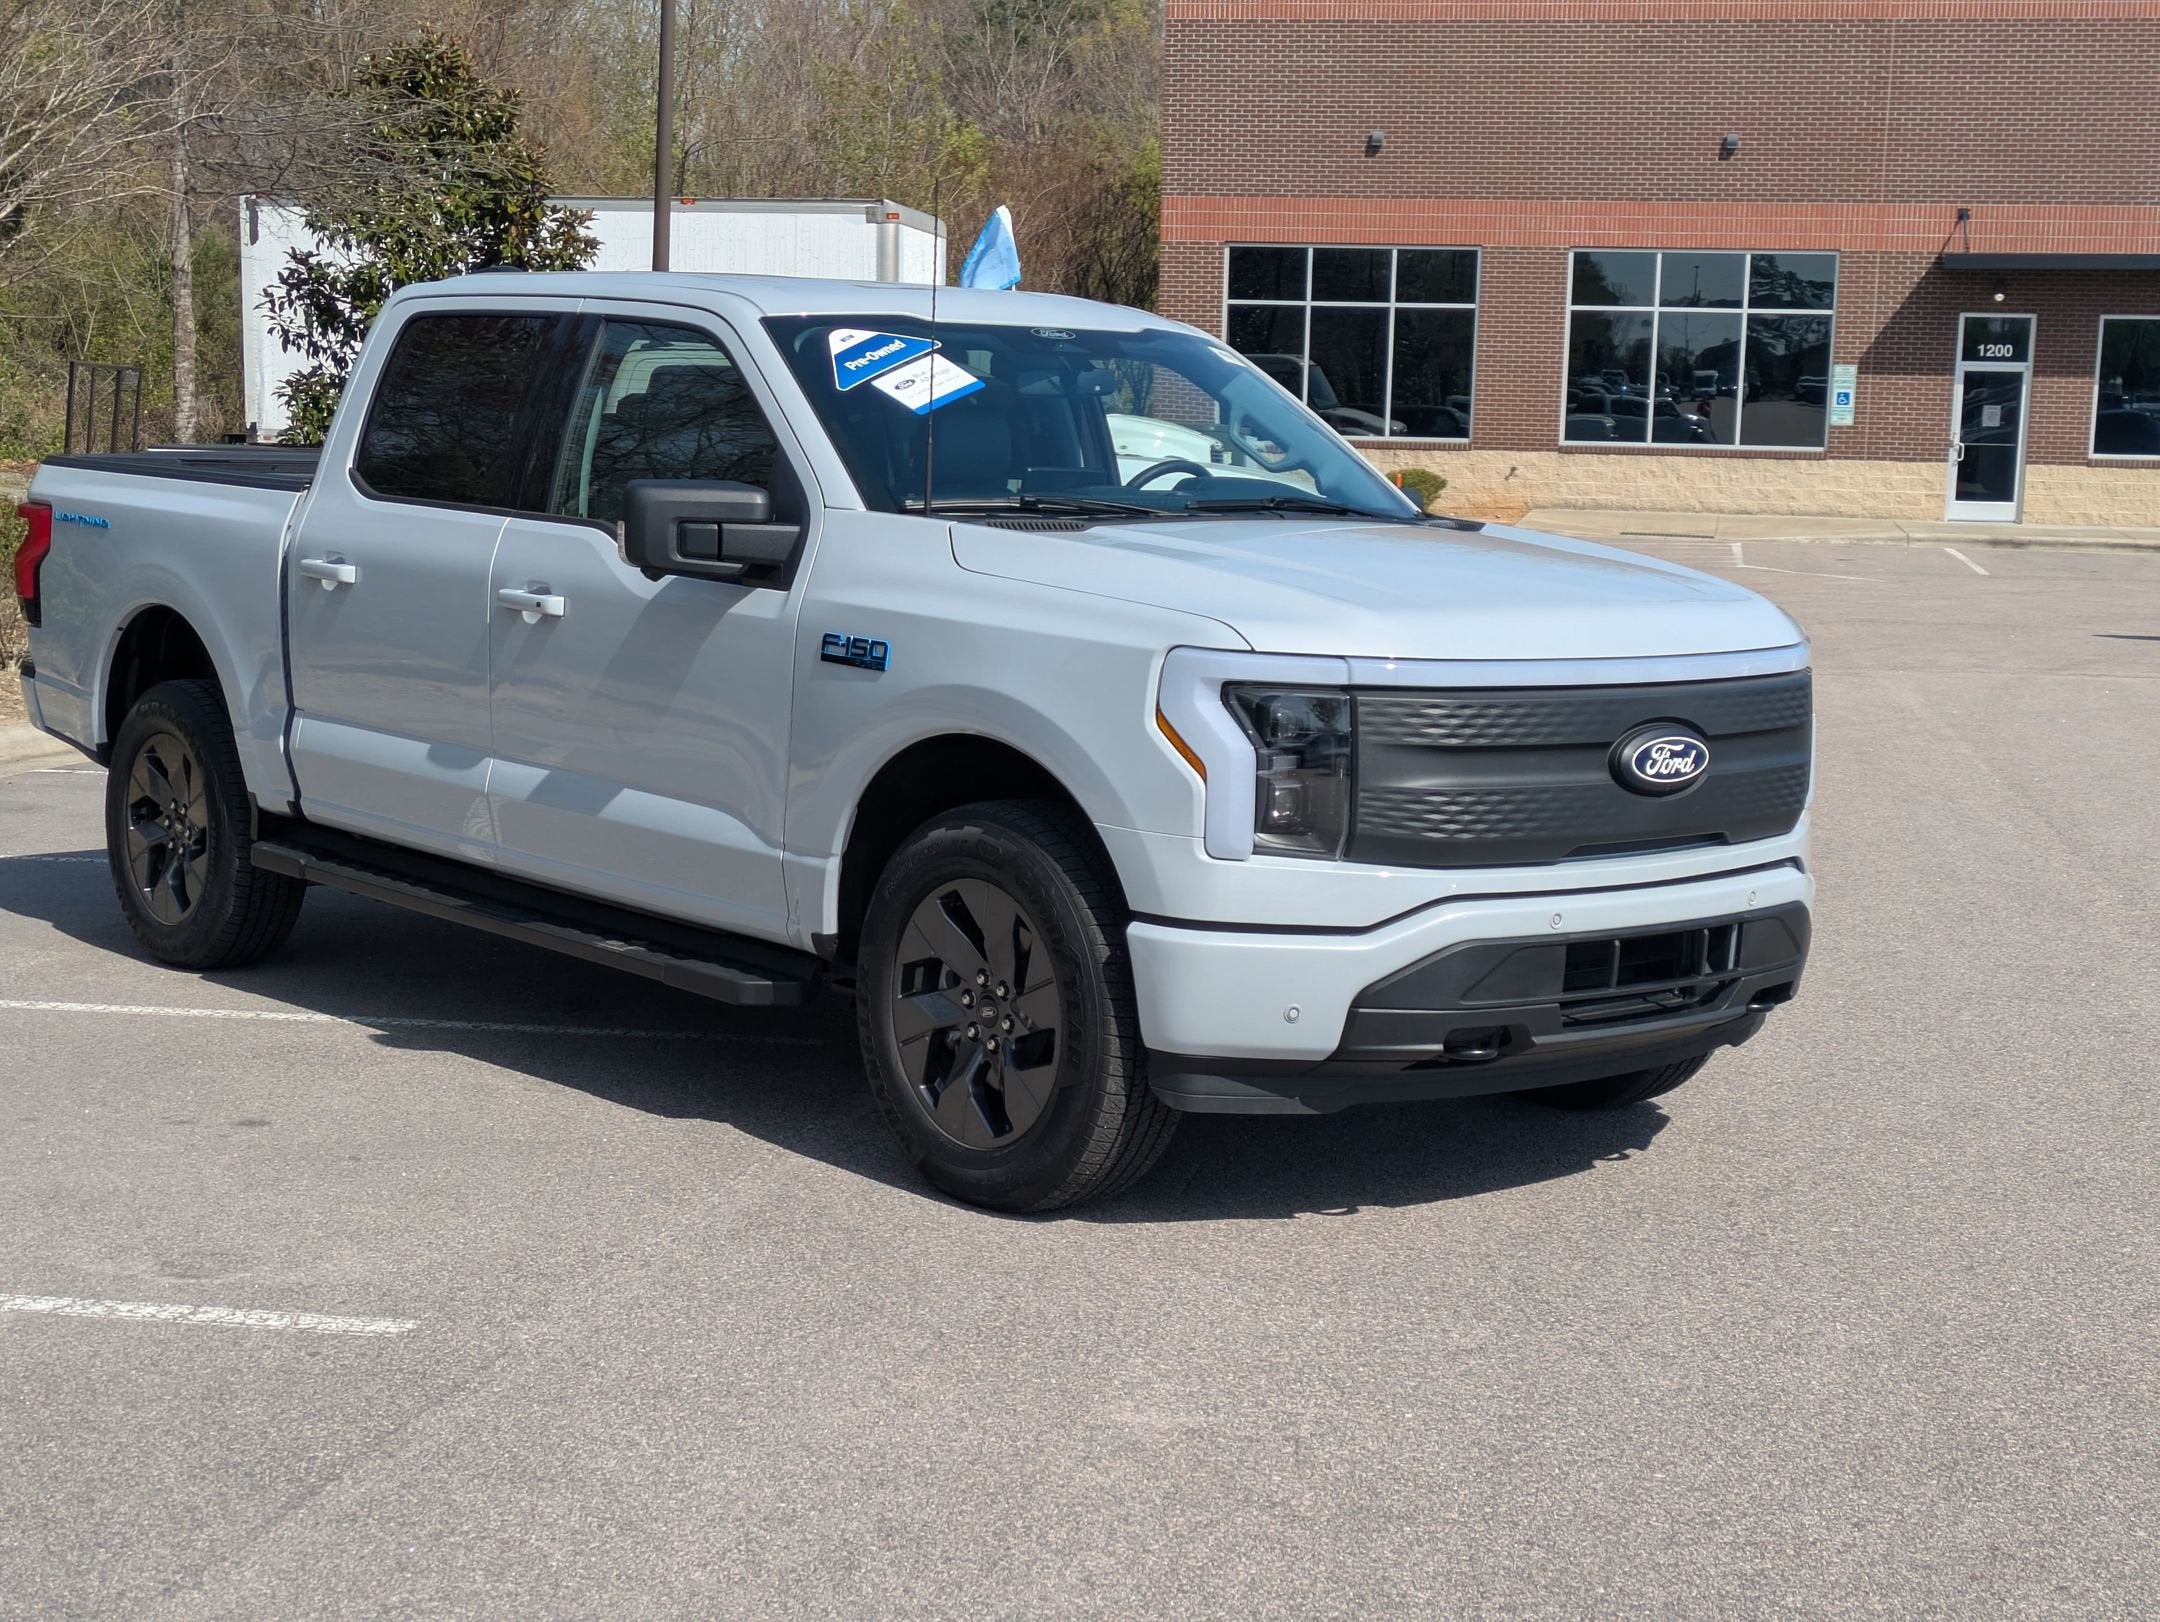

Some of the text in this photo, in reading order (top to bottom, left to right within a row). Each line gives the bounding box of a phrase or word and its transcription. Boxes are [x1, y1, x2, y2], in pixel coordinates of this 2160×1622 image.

[843, 339, 907, 371] Pre-Owned
[1977, 344, 2013, 357] 1200
[822, 632, 890, 666] F-150
[1646, 744, 1697, 775] Ford
